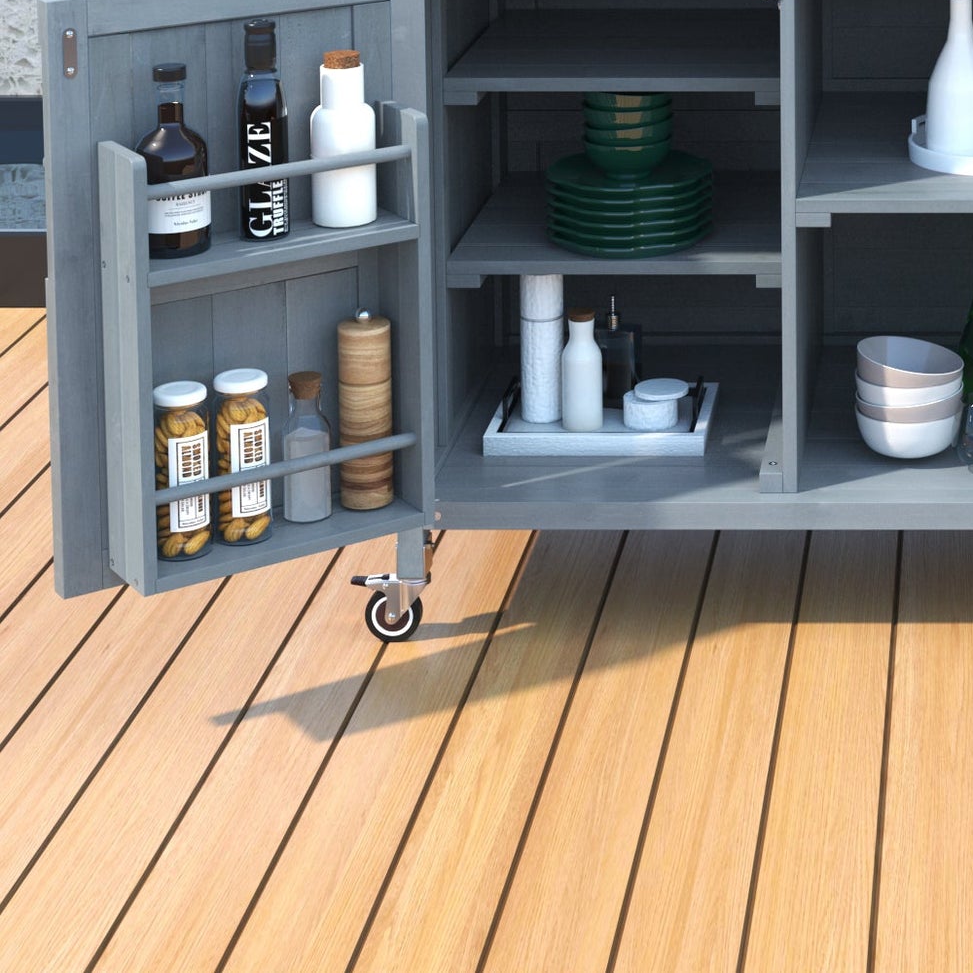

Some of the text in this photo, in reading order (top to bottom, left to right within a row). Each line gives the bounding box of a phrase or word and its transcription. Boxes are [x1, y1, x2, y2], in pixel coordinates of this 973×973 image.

[247, 121, 273, 237] GLZE
[272, 180, 283, 235] TRUFFLE
[182, 445, 192, 478] ALMOND
[193, 443, 202, 477] SMOKED
[243, 432, 254, 464] ALMOND
[254, 429, 263, 463] SMOKED
